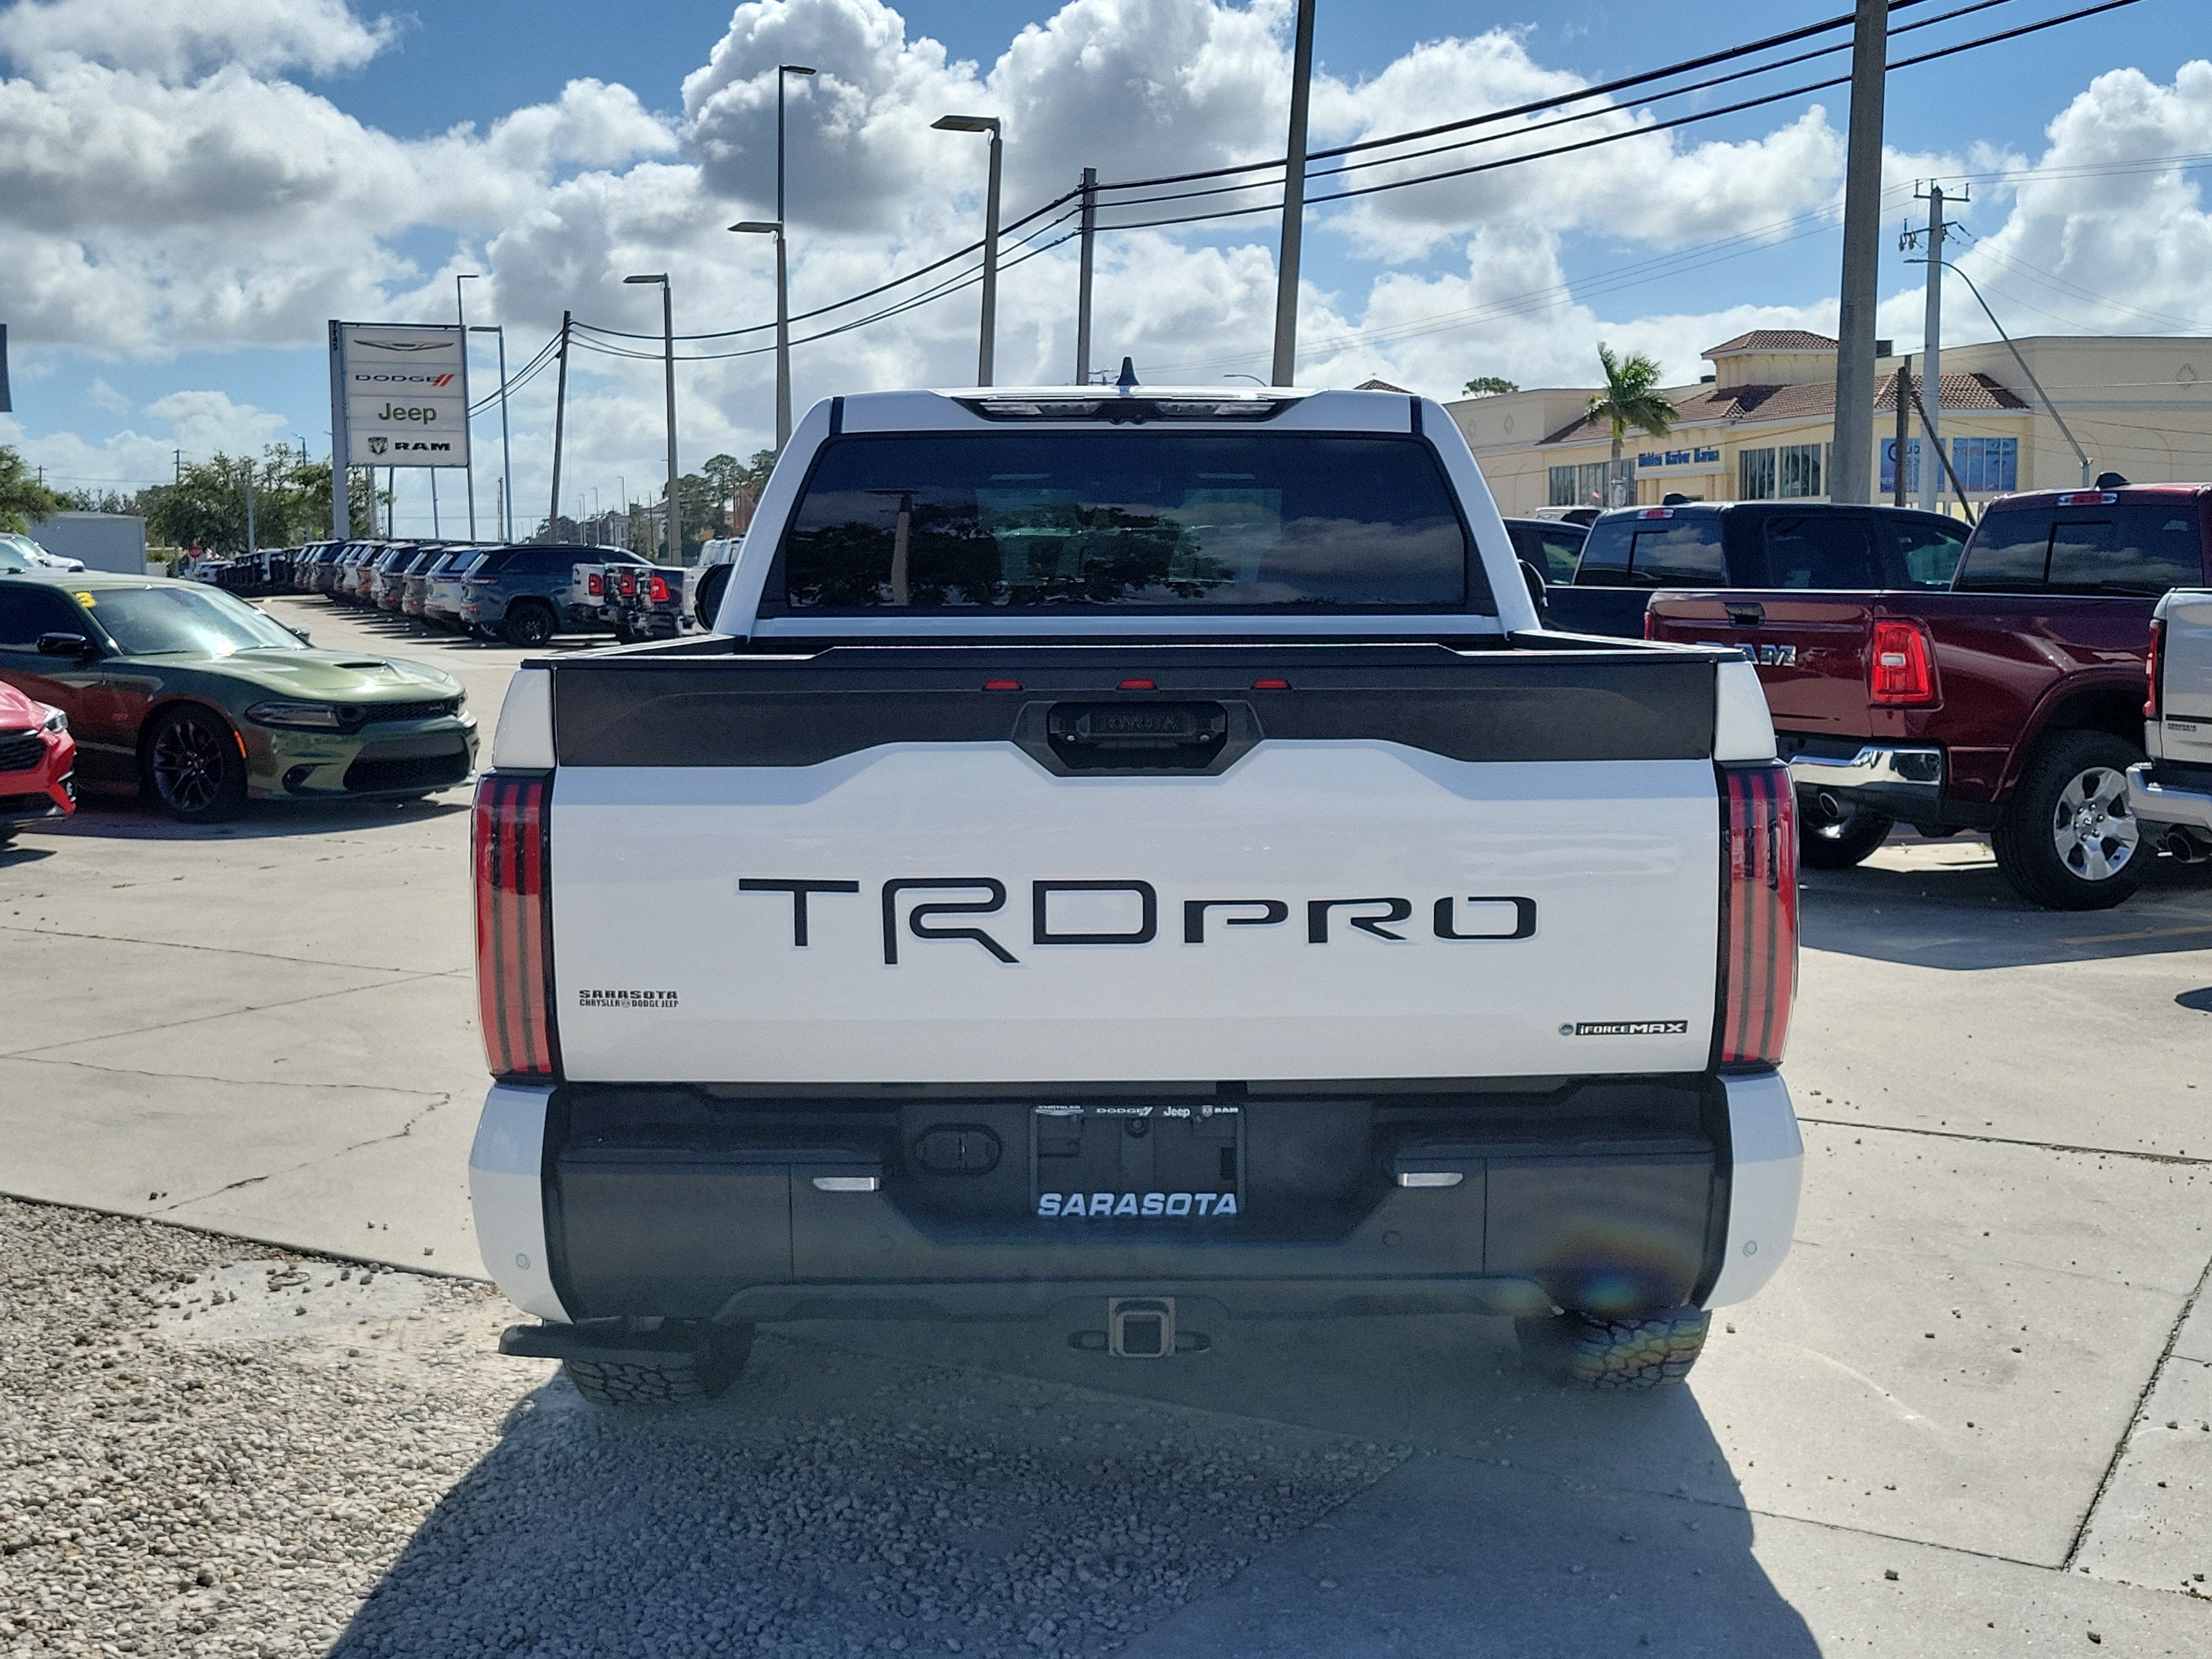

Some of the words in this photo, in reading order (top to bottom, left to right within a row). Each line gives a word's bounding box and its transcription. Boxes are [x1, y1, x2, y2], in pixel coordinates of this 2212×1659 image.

[378, 403, 437, 425] Jeep
[394, 442, 451, 451] RAM
[579, 990, 678, 999] SARASOTA
[1164, 1106, 1190, 1118] Jeep
[1038, 1193, 1237, 1216] SARASOTA
